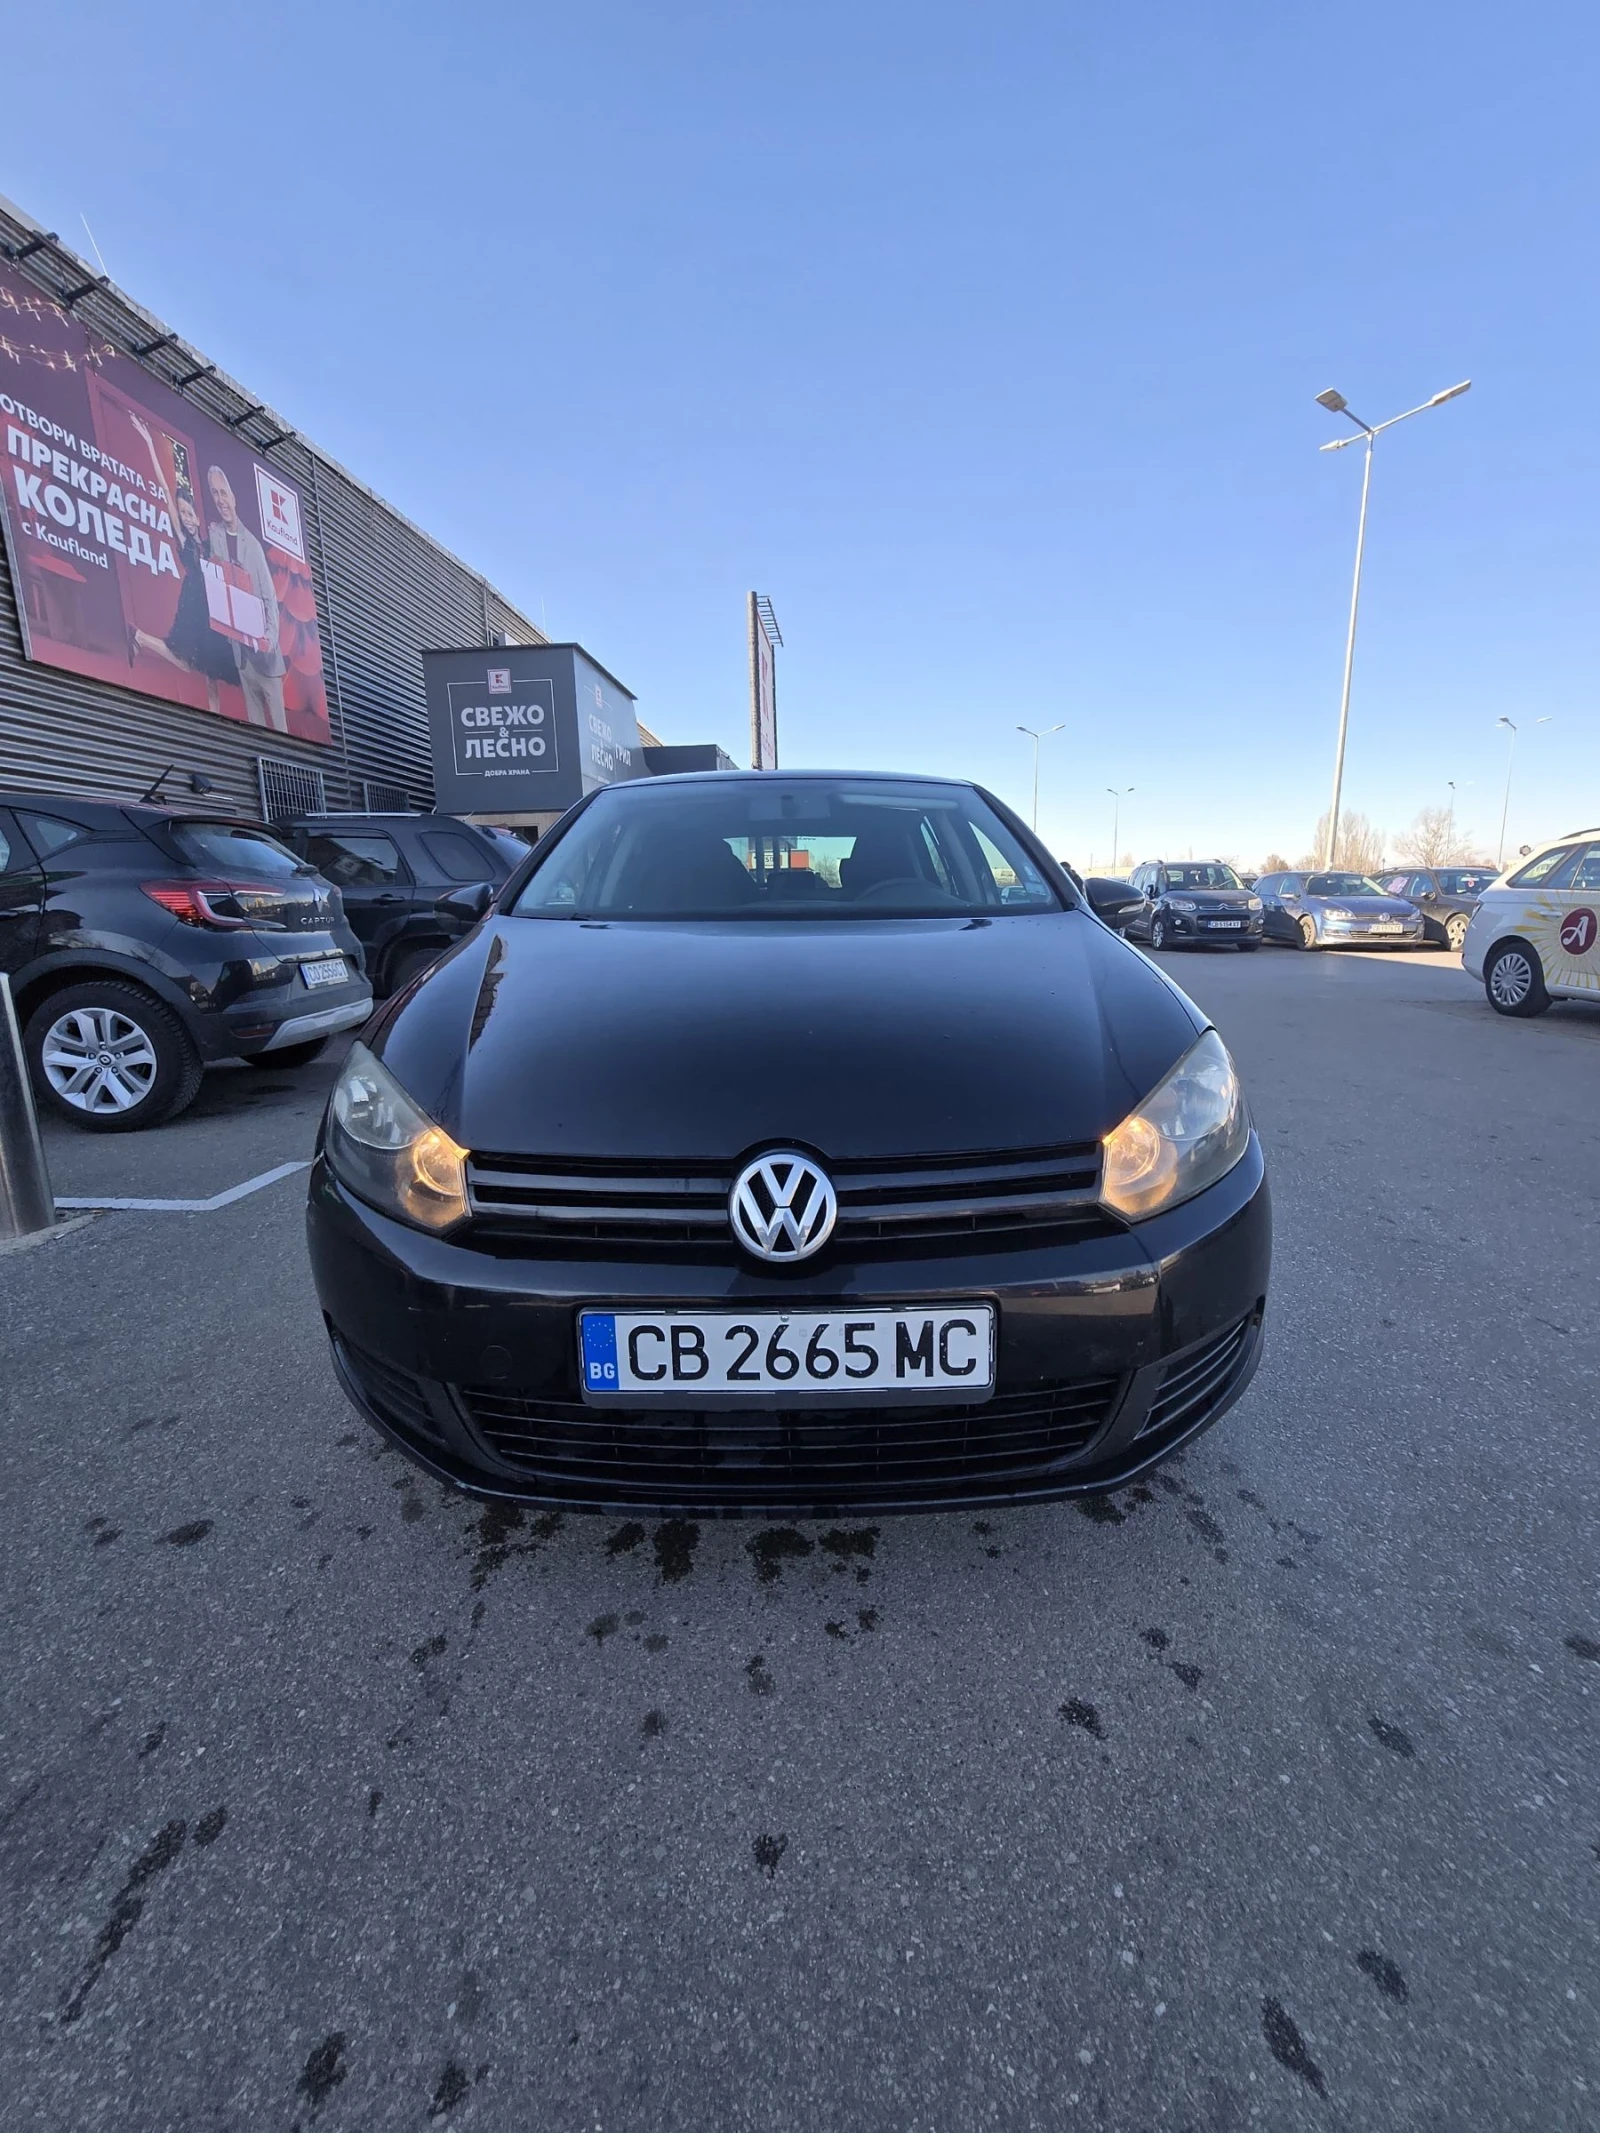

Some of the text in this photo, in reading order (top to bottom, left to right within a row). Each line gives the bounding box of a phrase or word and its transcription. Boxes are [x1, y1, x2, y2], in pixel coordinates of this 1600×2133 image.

[0, 394, 168, 504] ОТВОРИ ВРАТАТА ЗА
[8, 424, 174, 538] ПРЕКРАСНА
[13, 464, 180, 579] КОЛЕДА
[266, 518, 298, 545] Kaufland
[35, 522, 108, 569] Kaufland
[461, 705, 544, 727] СВЕЖО
[499, 727, 509, 738] &
[465, 737, 546, 759] ЛЕСНО
[591, 743, 614, 771] ЛЕСНО
[615, 743, 631, 767] ГРИЛ
[484, 768, 530, 778] ДОБРА ХРАНА
[589, 1319, 977, 1381] BG CB 2665 MC
